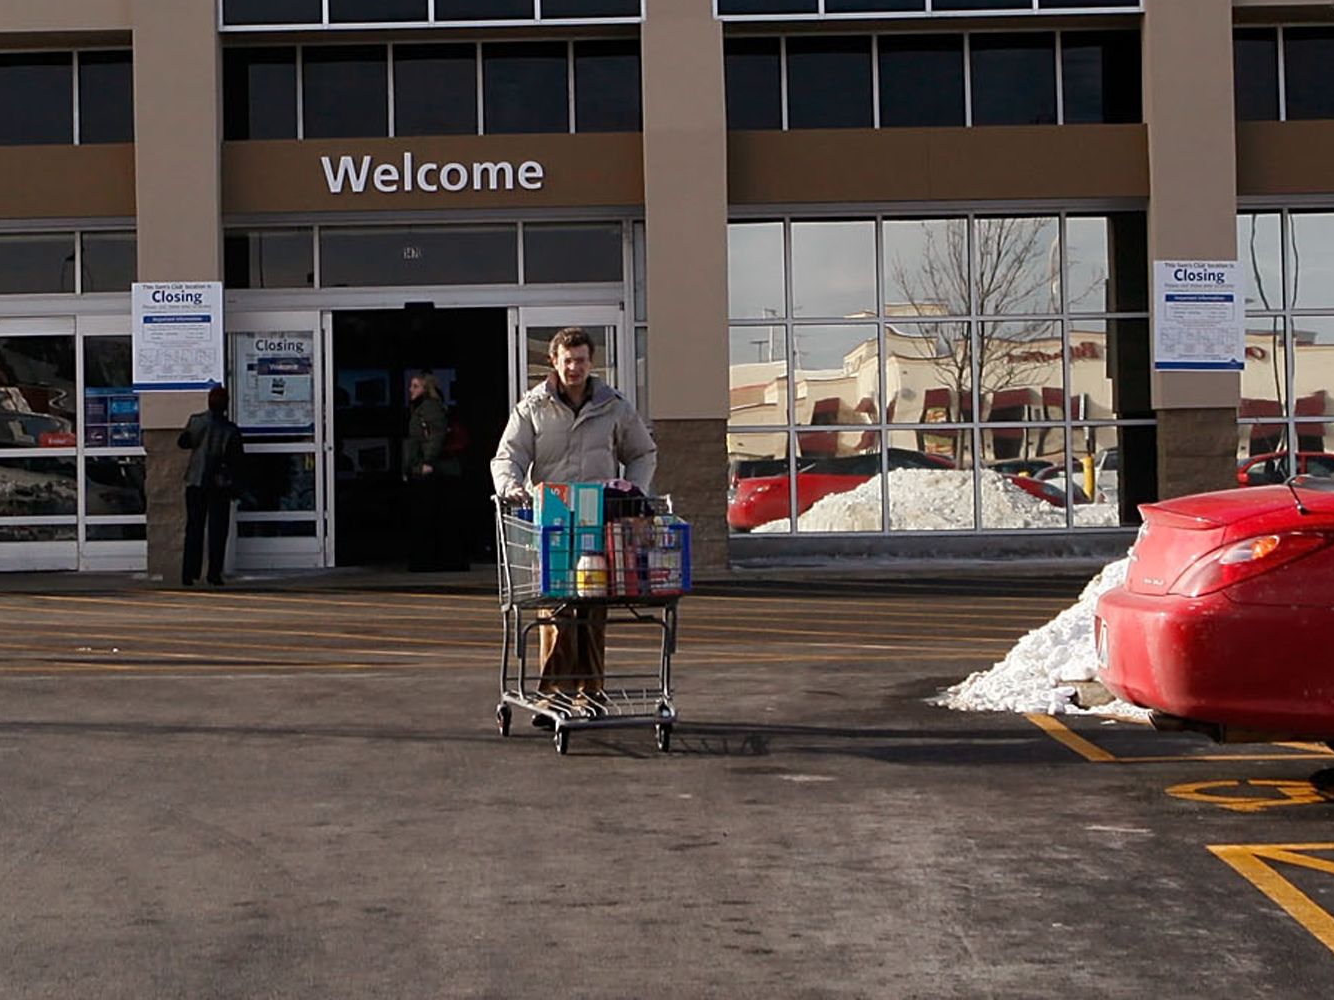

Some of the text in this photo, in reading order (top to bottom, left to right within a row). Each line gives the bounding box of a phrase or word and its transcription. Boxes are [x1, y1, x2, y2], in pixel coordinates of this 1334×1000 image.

[321, 152, 544, 193] Welcome
[1174, 268, 1225, 284] Closing
[152, 290, 203, 305] Closing
[255, 338, 304, 353] Closing
